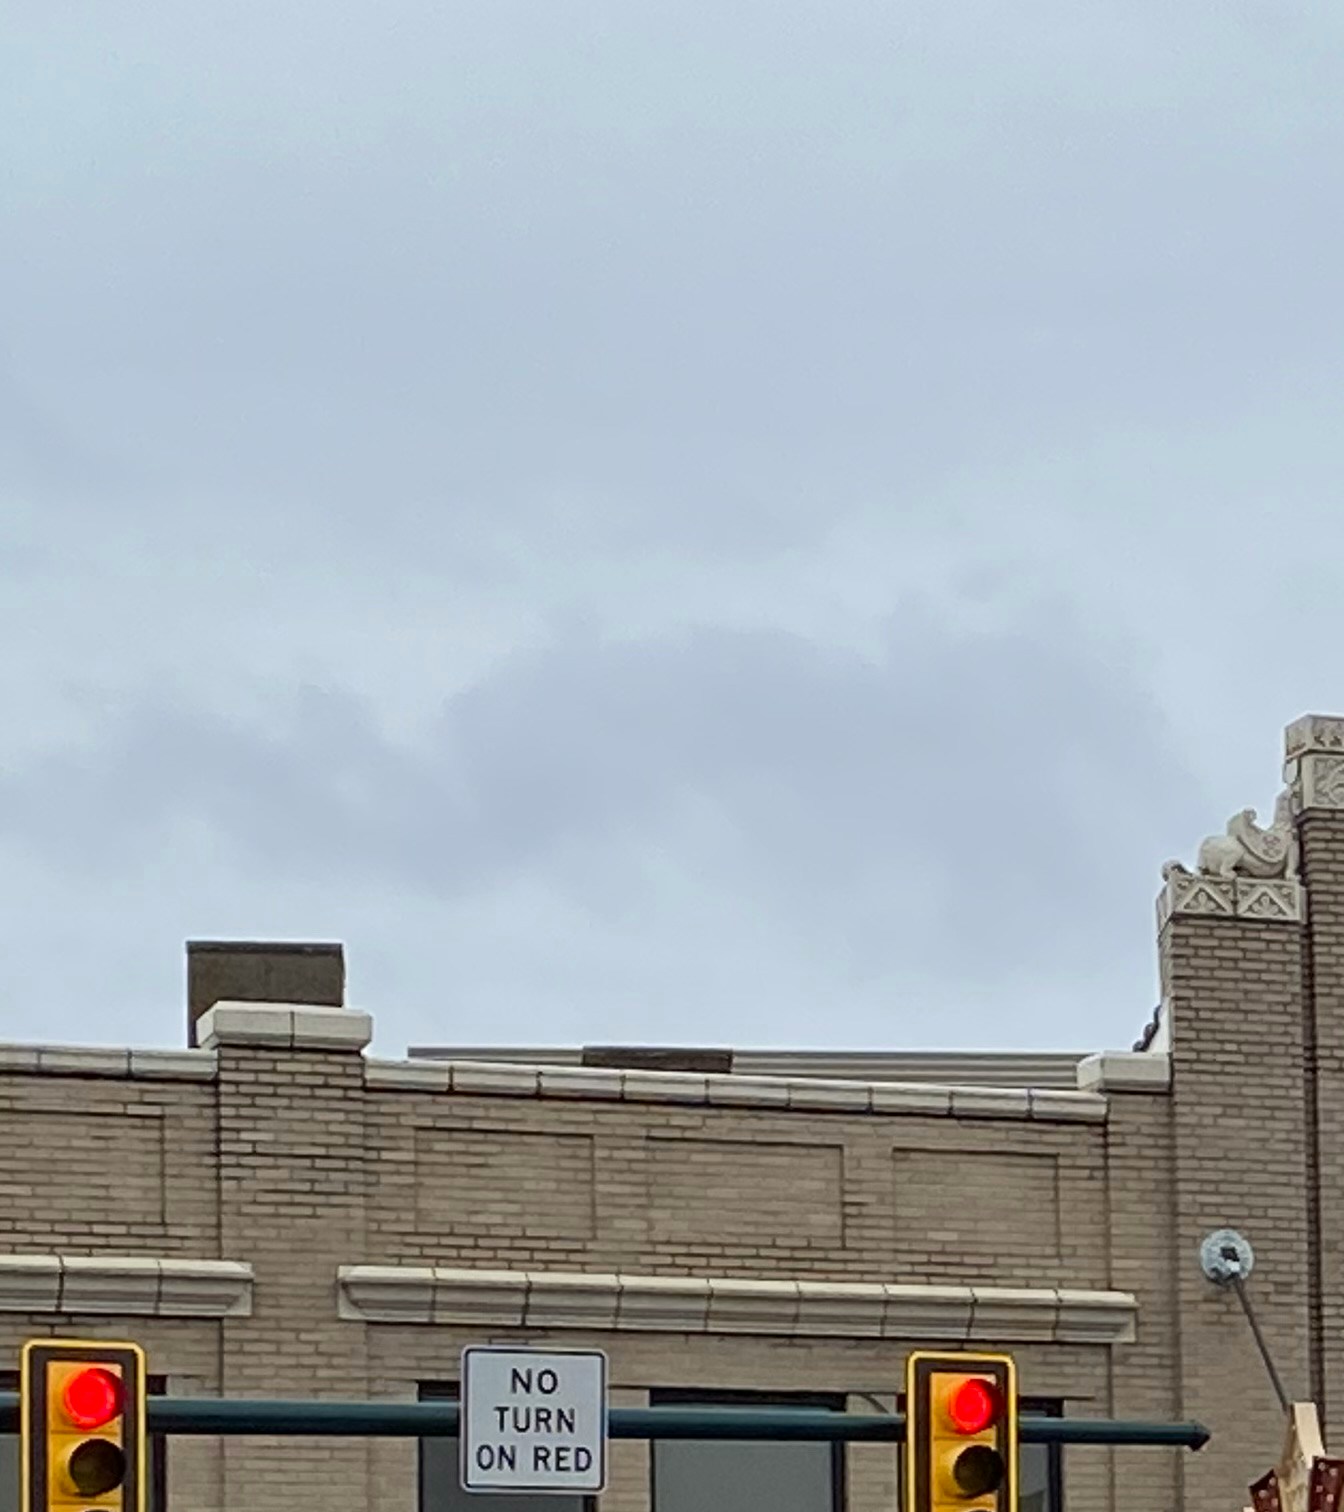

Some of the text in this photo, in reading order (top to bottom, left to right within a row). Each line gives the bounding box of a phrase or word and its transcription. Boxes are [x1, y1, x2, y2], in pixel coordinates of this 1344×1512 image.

[511, 1368, 558, 1394] NO
[494, 1406, 576, 1434] TURN
[476, 1445, 592, 1472] ON RED
